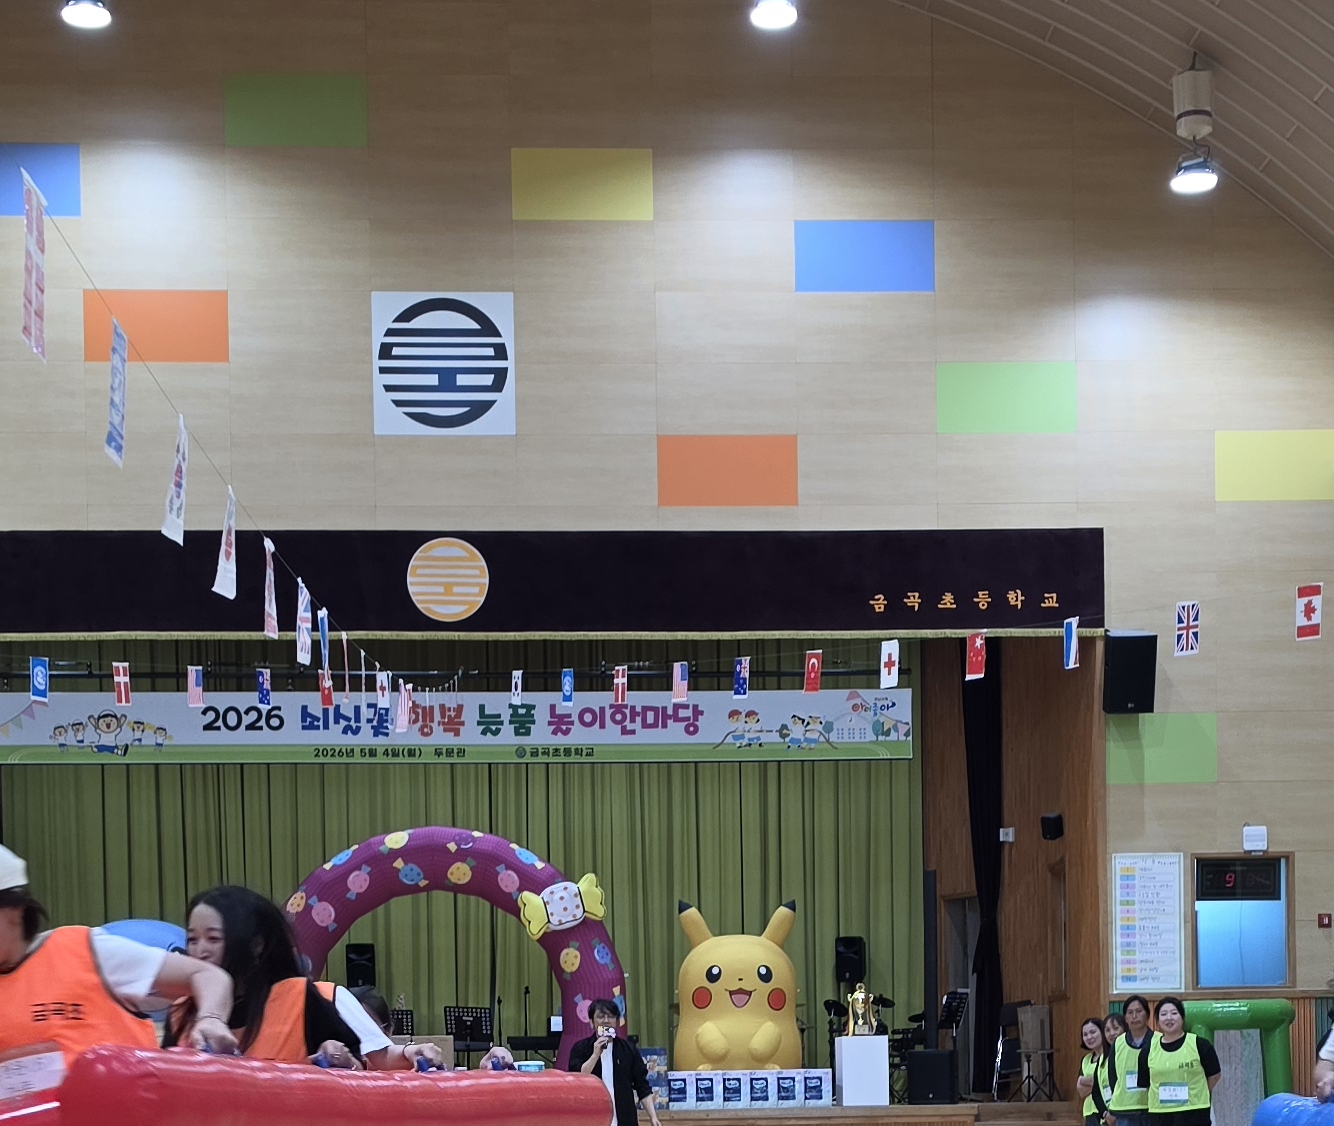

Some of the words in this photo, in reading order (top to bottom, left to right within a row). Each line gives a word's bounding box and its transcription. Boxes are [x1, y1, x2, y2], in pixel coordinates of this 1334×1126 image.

[200, 705, 285, 732] 2026
[476, 703, 537, 738] 늘품
[547, 703, 705, 737] 놀이한마당
[313, 747, 355, 759] 2026년
[360, 747, 378, 759] 5월
[382, 747, 423, 759] 4일(월)
[529, 747, 595, 758] 금곡초등학교
